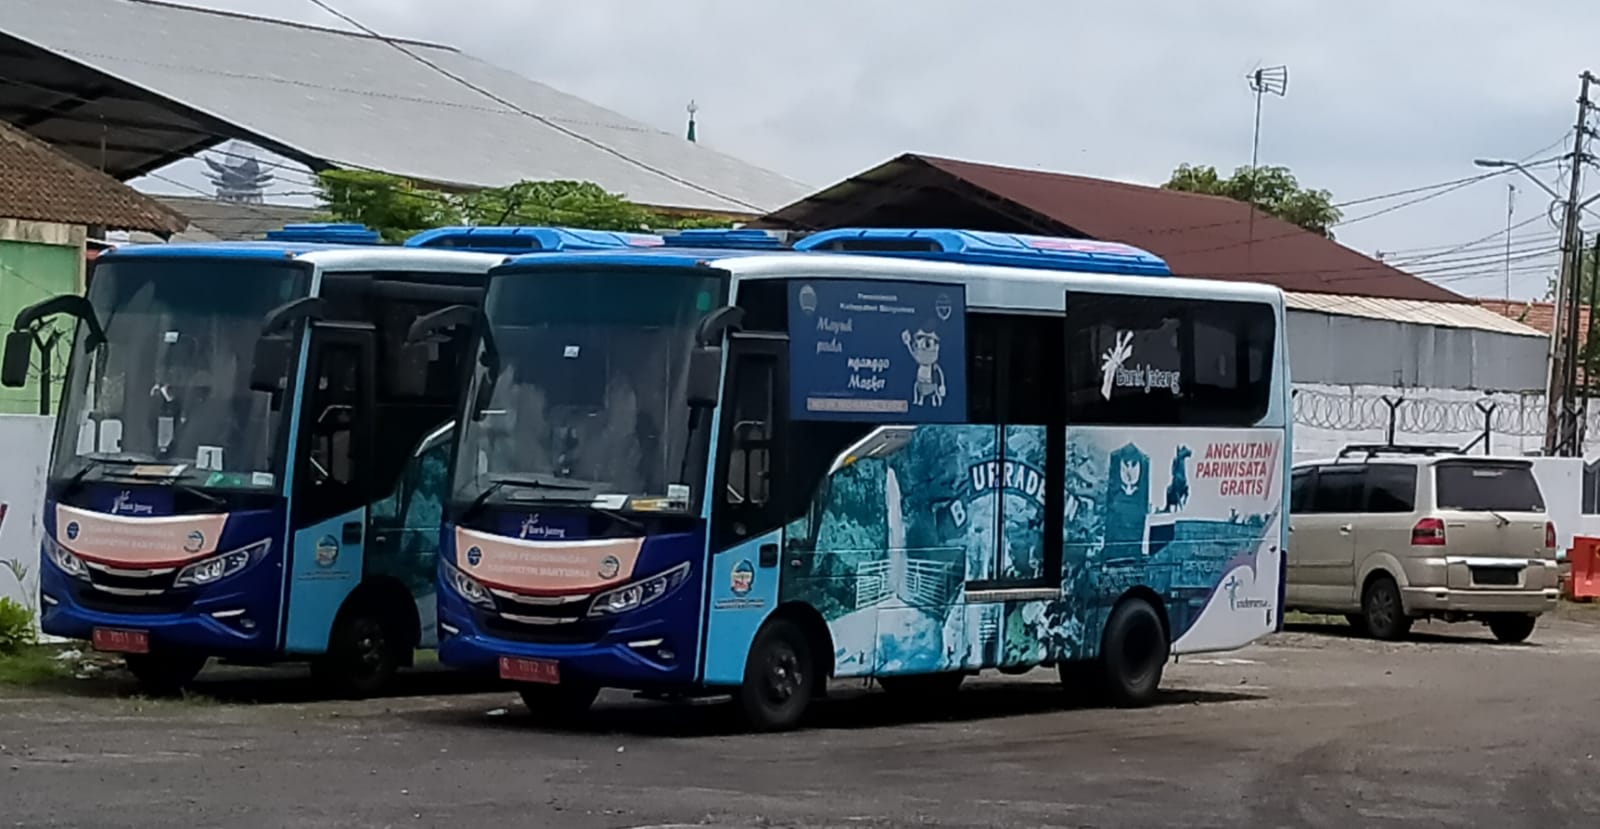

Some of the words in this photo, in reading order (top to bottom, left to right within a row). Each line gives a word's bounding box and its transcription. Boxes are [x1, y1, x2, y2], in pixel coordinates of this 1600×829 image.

[1205, 442, 1273, 460] ANGKUTAN
[1196, 460, 1267, 478] PARIWISATA
[1220, 479, 1264, 496] GRATIS
